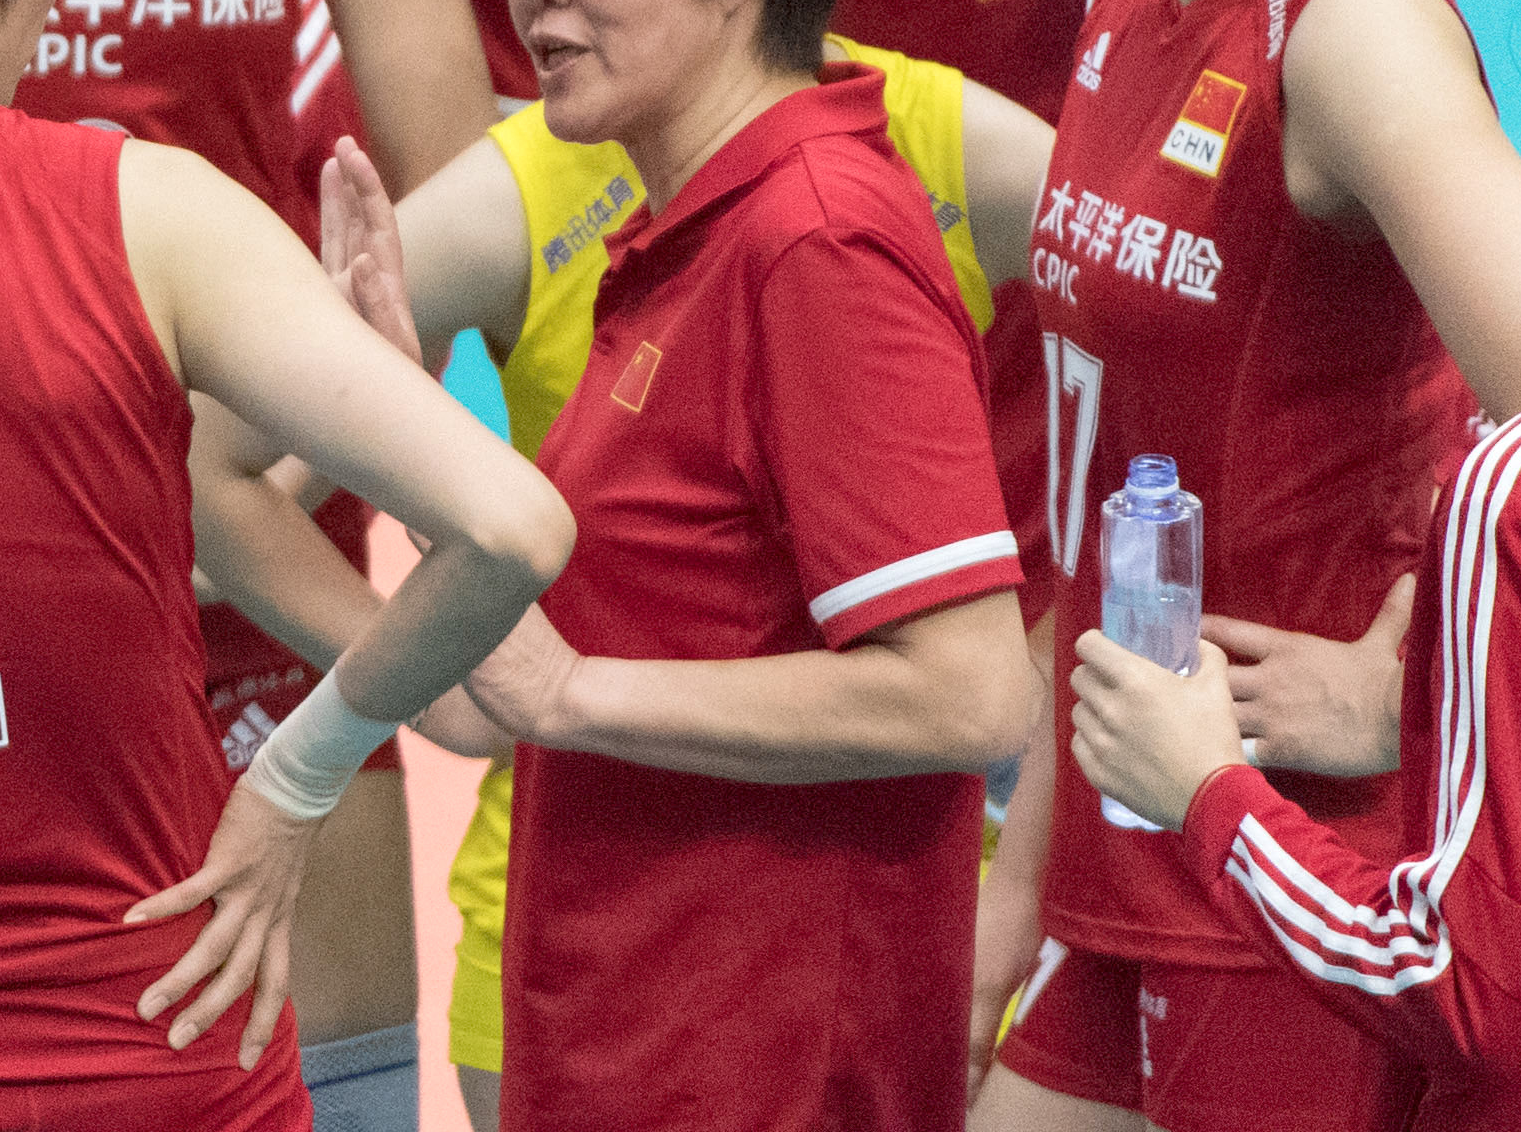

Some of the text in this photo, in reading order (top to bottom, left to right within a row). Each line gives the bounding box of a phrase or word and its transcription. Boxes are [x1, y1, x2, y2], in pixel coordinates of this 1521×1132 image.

[24, 33, 123, 75] PIC
[1171, 130, 1216, 163] CHN
[1034, 247, 1079, 305] CPIC
[1042, 331, 1103, 577] 17
